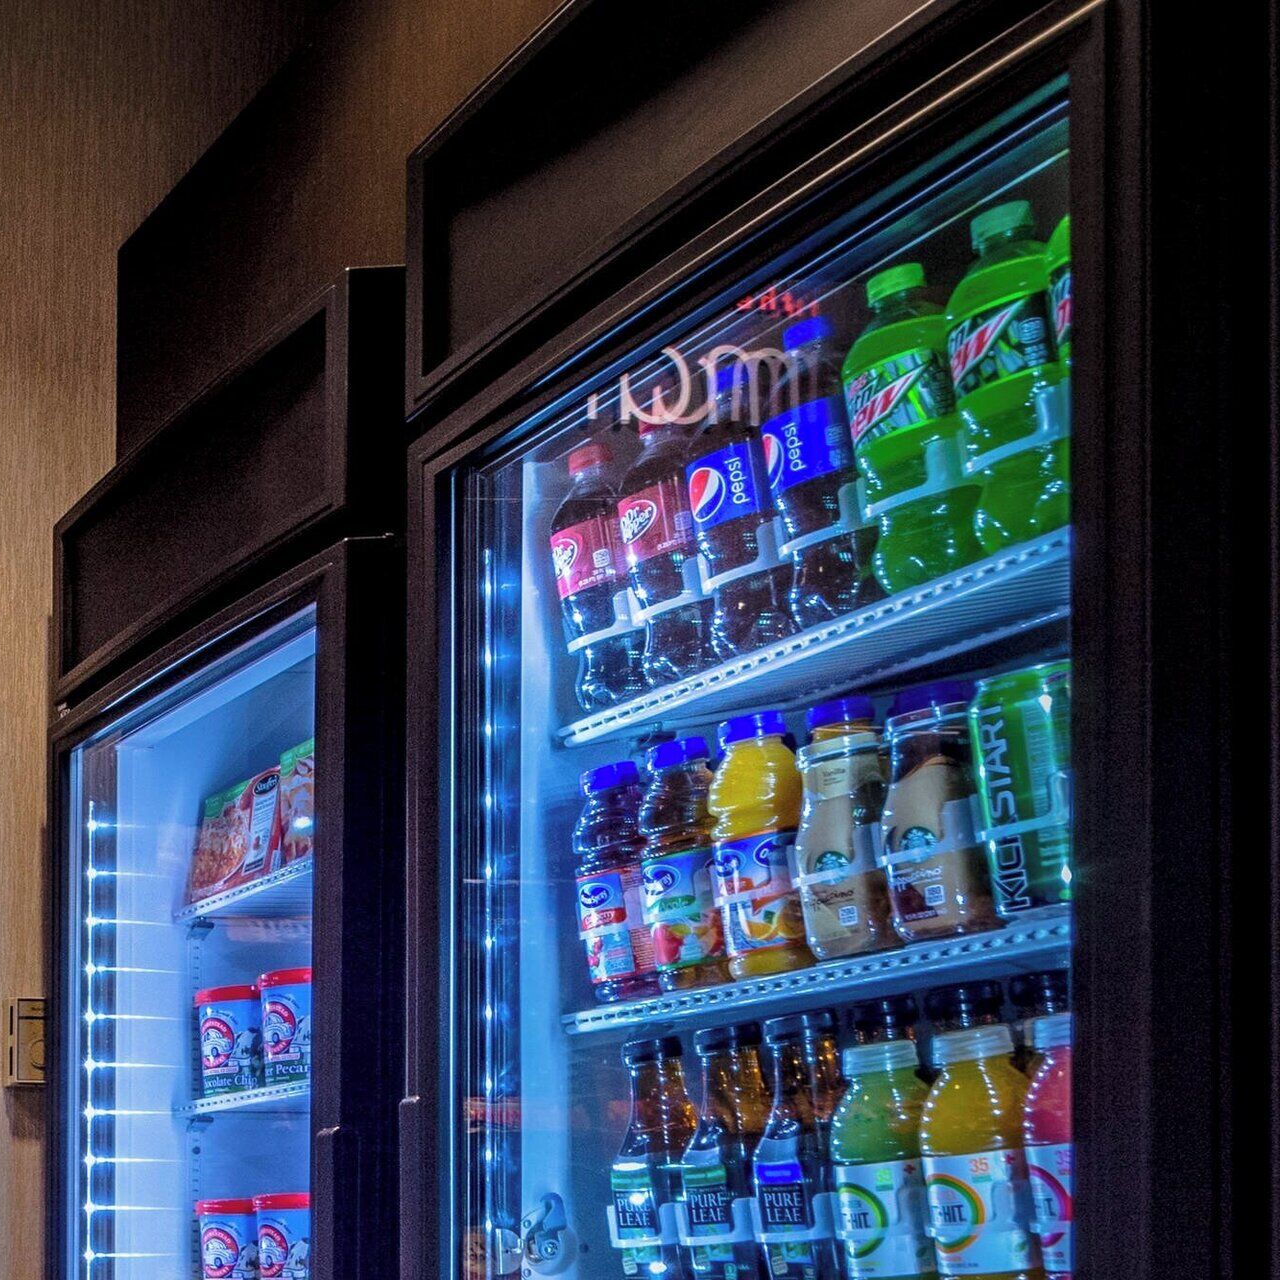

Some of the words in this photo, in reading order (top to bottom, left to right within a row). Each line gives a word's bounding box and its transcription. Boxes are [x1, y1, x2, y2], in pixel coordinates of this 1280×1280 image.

[783, 422, 805, 473] pepsi
[725, 458, 748, 505] pepsi
[981, 705, 1030, 914] KICSTART
[234, 1073, 258, 1090] Chip
[969, 1157, 989, 1174] 35
[690, 1193, 724, 1210] PURE
[764, 1191, 800, 1209] PURE
[618, 1210, 650, 1228] LEAF
[692, 1206, 725, 1223] LEAF
[766, 1206, 802, 1223] LEAF
